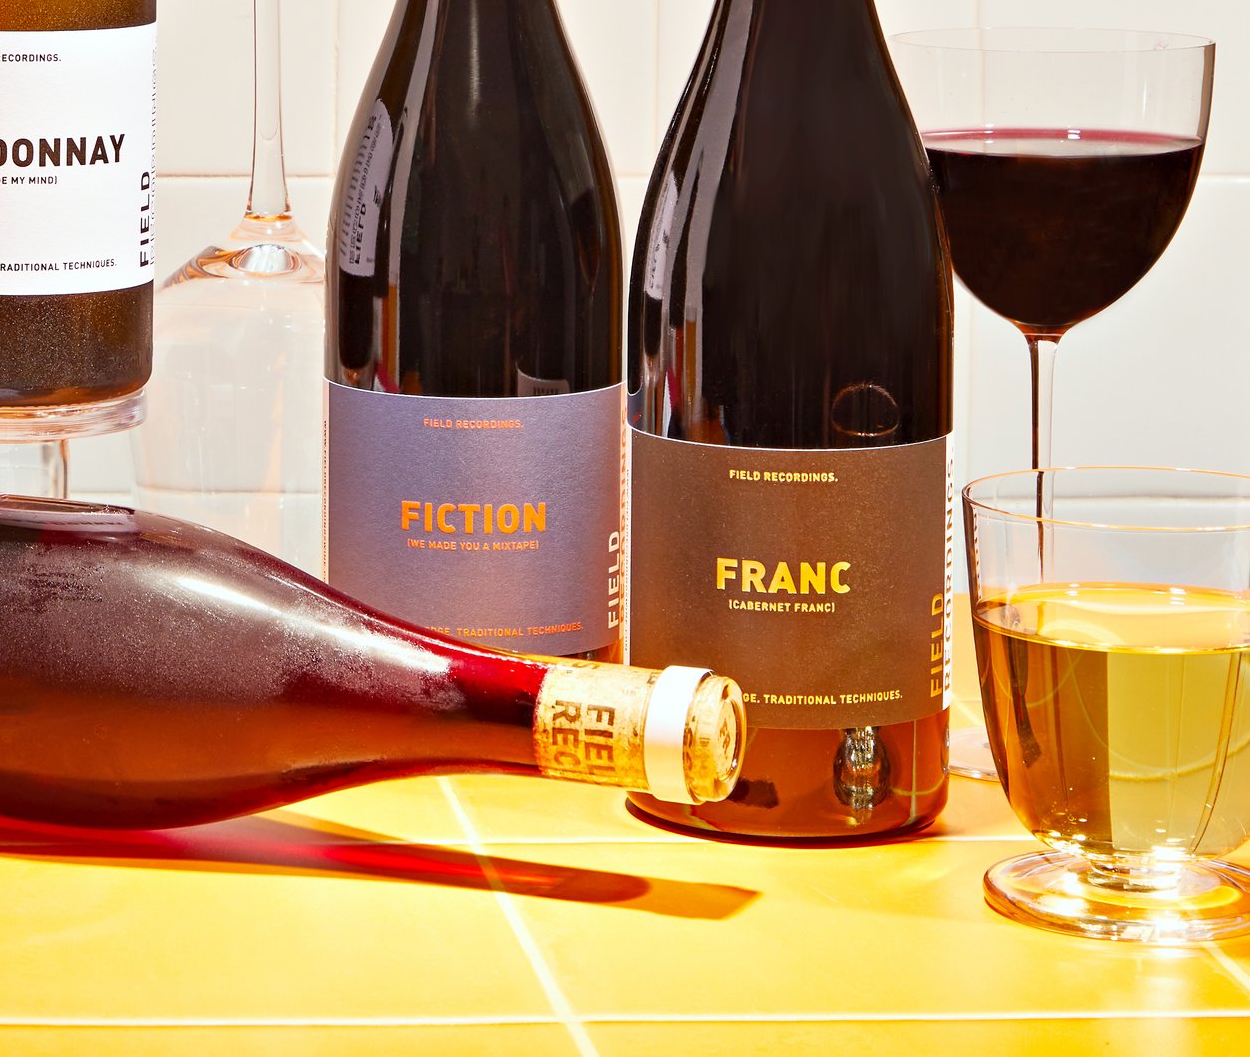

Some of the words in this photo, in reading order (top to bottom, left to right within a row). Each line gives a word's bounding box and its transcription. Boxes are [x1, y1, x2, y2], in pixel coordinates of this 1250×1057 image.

[11, 176, 25, 184] MY
[28, 175, 58, 185] MIND)
[139, 171, 150, 267] FIELD
[63, 258, 117, 270] TECHNIQUES.
[423, 418, 453, 429] FIELD
[456, 419, 524, 429] RECORDINGS.
[729, 469, 761, 481] FIELD
[763, 471, 839, 482] RECORDINGS.
[401, 500, 546, 534] FICTION
[407, 538, 426, 548] (WE
[428, 539, 457, 551] MADE
[459, 541, 480, 551] YOU
[483, 542, 490, 551] A
[492, 539, 539, 551] MIXTAPE)
[608, 531, 620, 629] FIELD
[716, 557, 851, 594] FRANC
[729, 599, 791, 612] (CABERNET
[794, 602, 835, 613] FRANC)
[456, 627, 524, 637] TRADITIONAL
[527, 622, 584, 636] TECHNIQUES.
[930, 592, 943, 698] FIELD
[763, 694, 837, 705] TRADITIONAL
[840, 689, 902, 704] TECHNIQUES.
